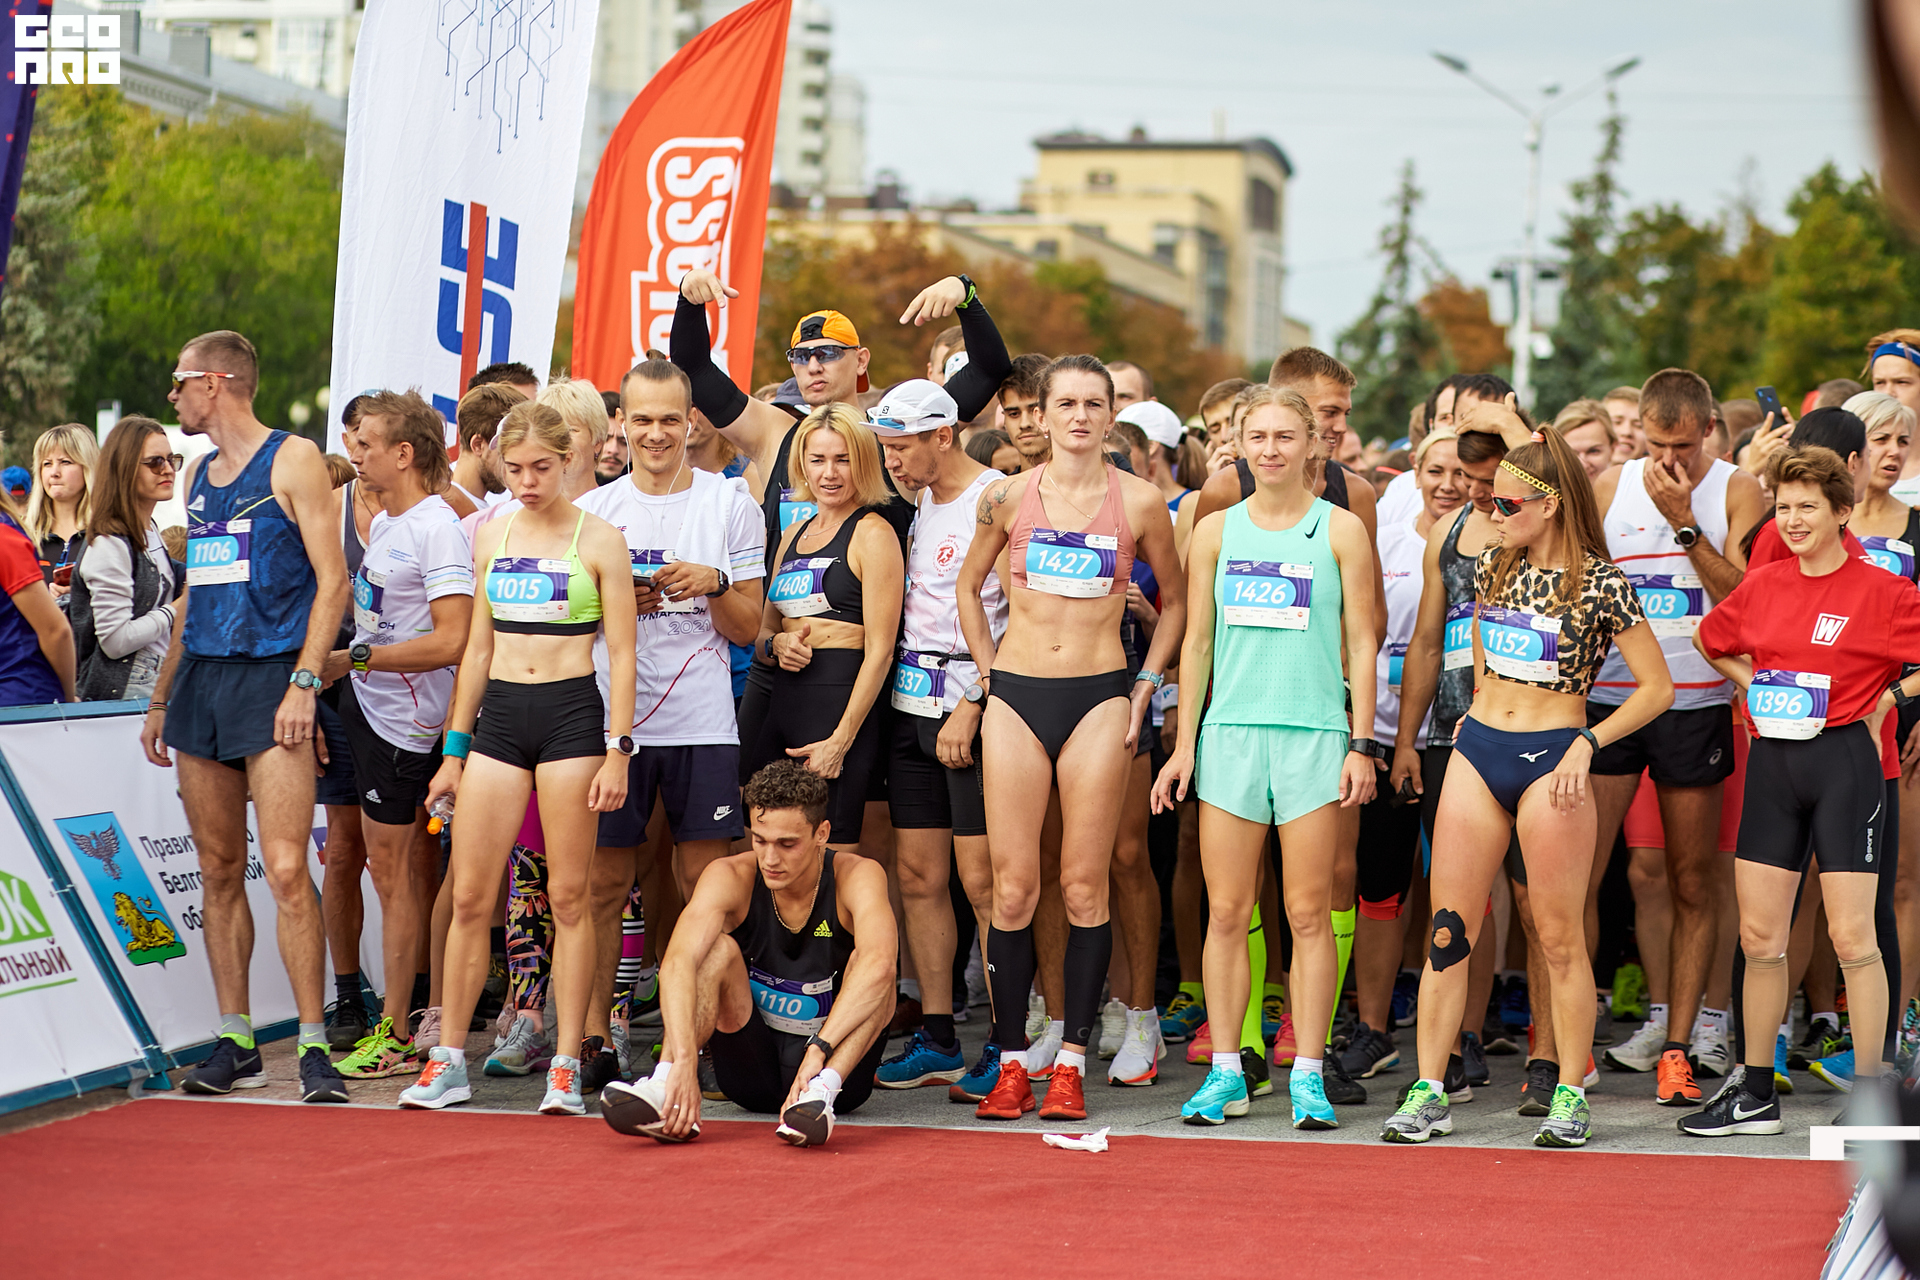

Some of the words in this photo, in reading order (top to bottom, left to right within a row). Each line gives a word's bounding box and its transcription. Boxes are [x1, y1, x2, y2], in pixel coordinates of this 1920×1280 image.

[194, 541, 231, 563] 1106
[1038, 550, 1094, 574] 1427
[497, 578, 542, 600] 1015
[775, 574, 810, 597] 1408
[1234, 581, 1287, 604] 1426
[1639, 593, 1676, 615] 103
[668, 619, 711, 636] 2021
[1450, 624, 1473, 647] 114
[1815, 617, 1844, 642] W
[1488, 629, 1531, 656] 1152
[1755, 690, 1803, 715] 1396
[0, 937, 72, 985] льный
[760, 990, 802, 1016] 1110
